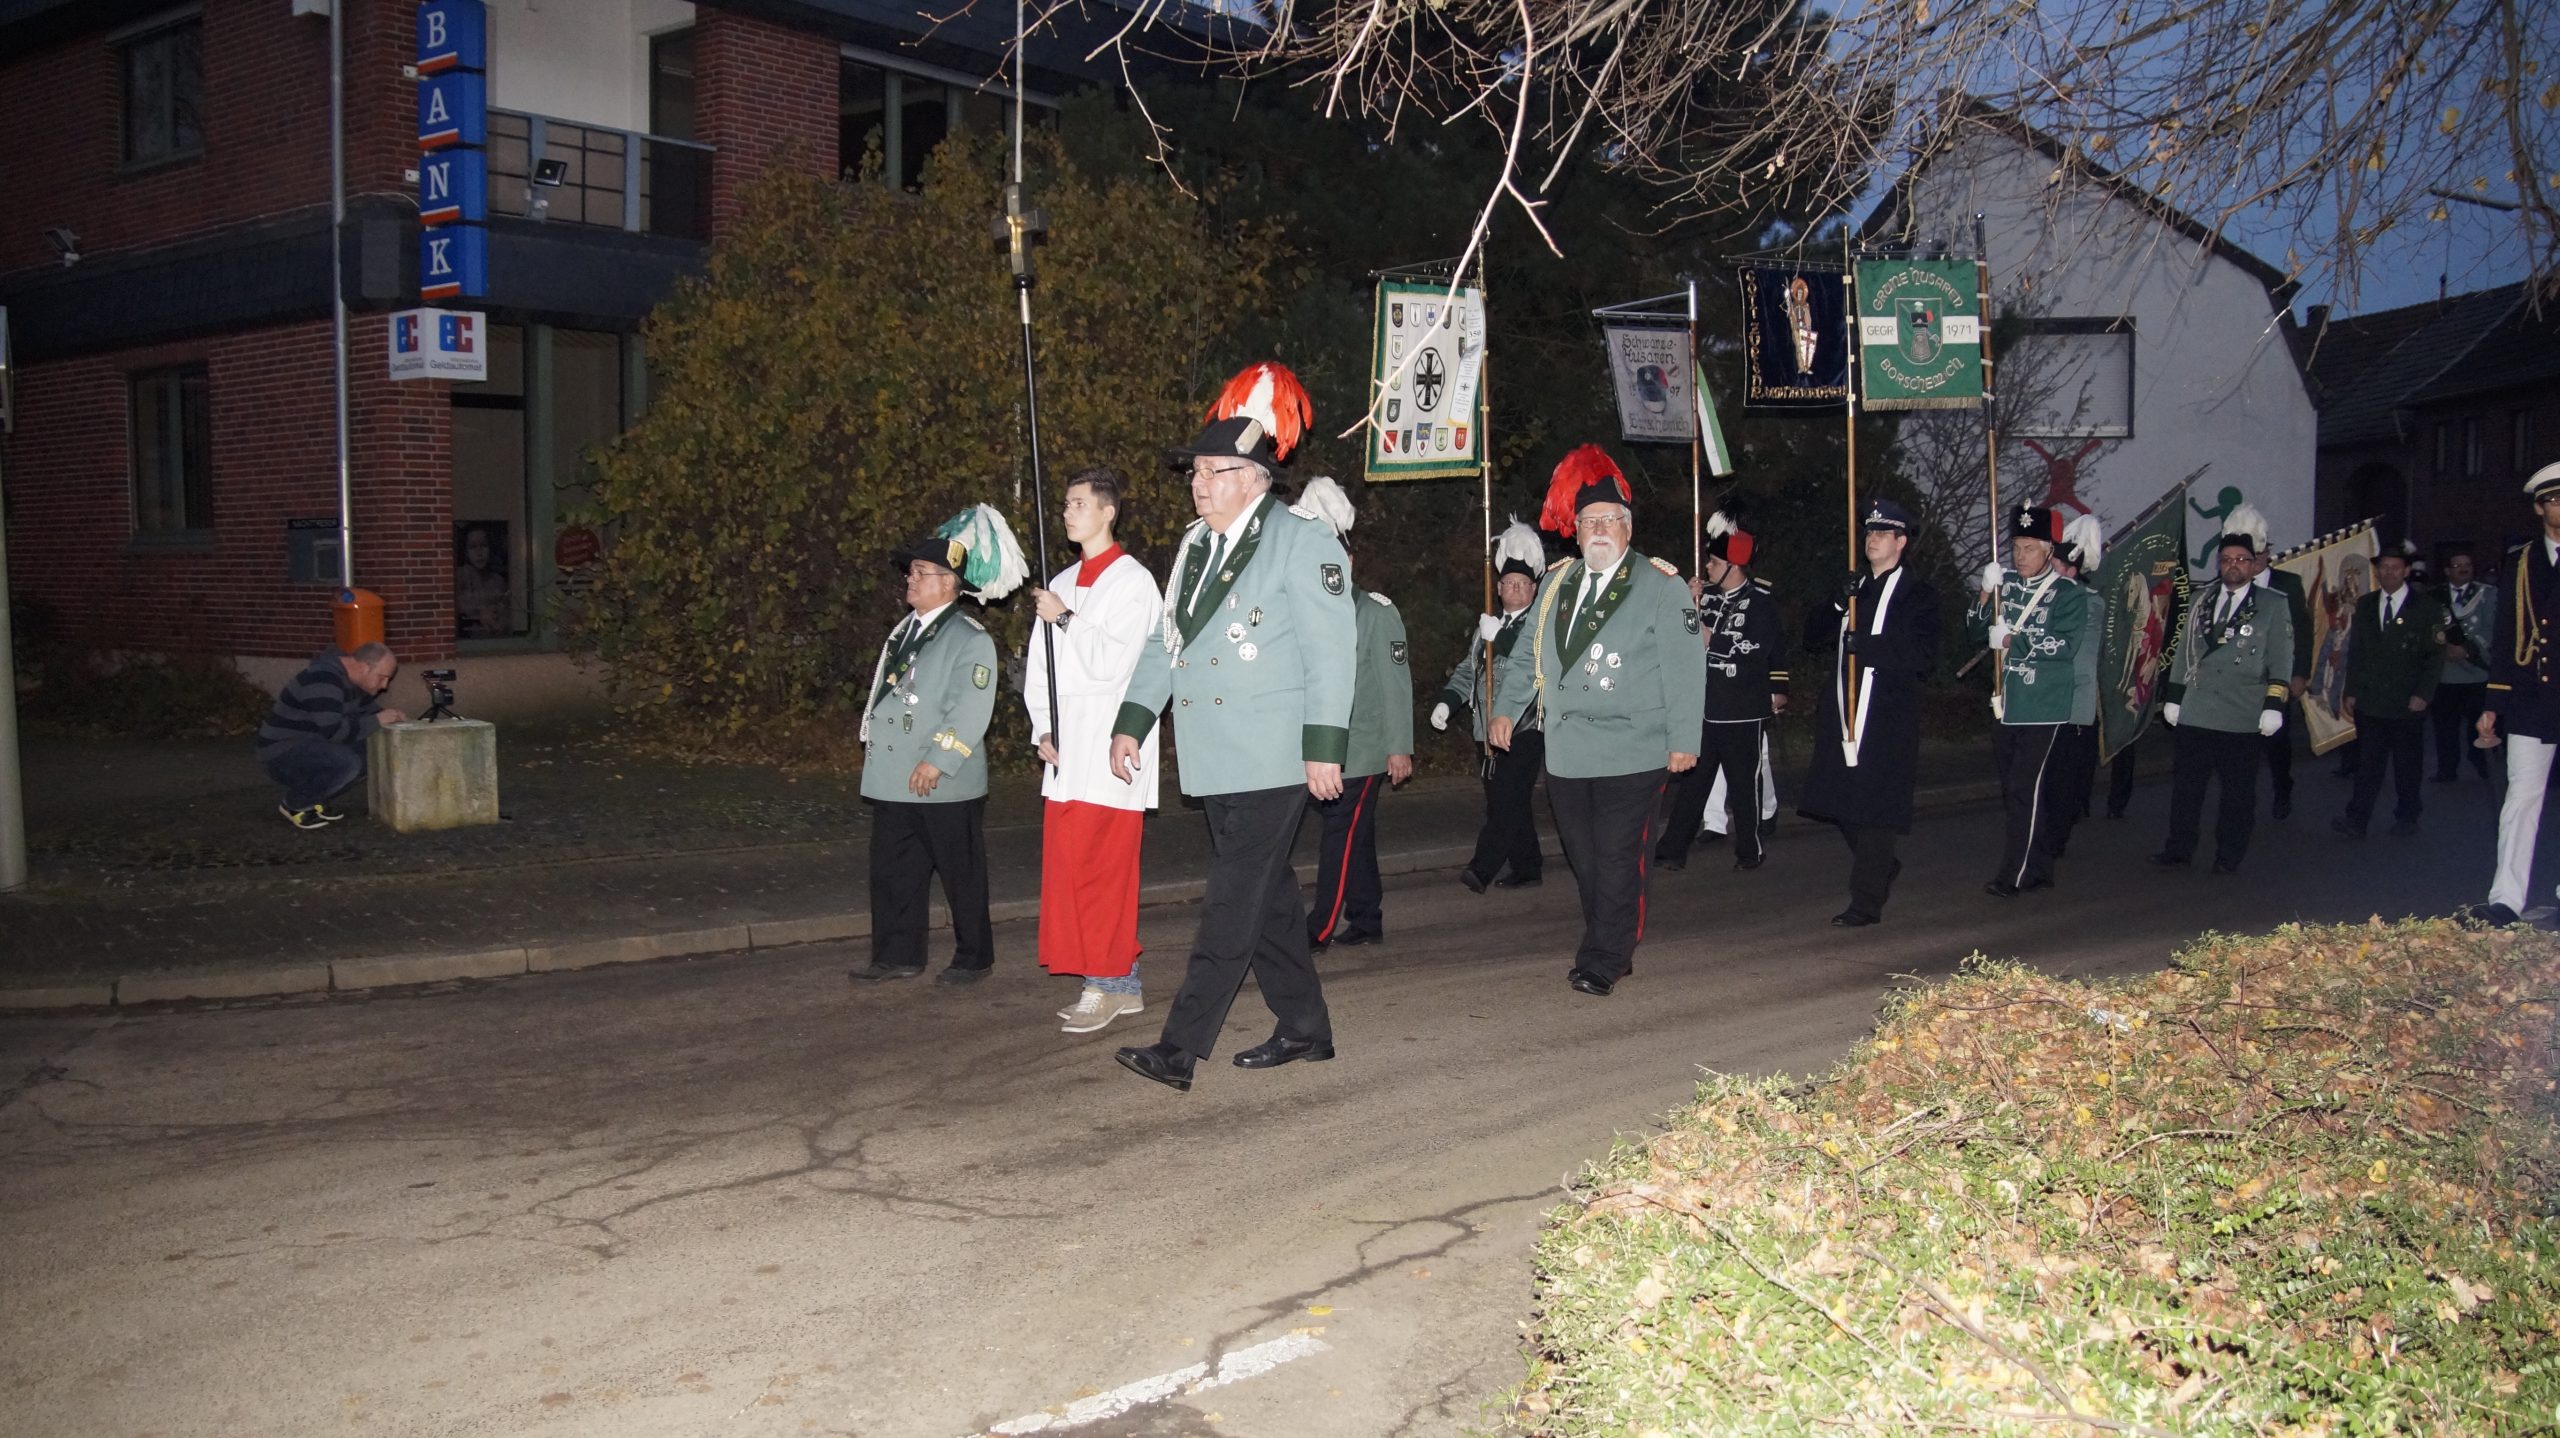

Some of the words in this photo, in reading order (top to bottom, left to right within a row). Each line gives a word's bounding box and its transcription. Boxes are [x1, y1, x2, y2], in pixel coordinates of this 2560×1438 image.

[425, 10, 452, 275] BANK
[1946, 324, 1972, 337] 1971
[1669, 385, 1681, 398] 97
